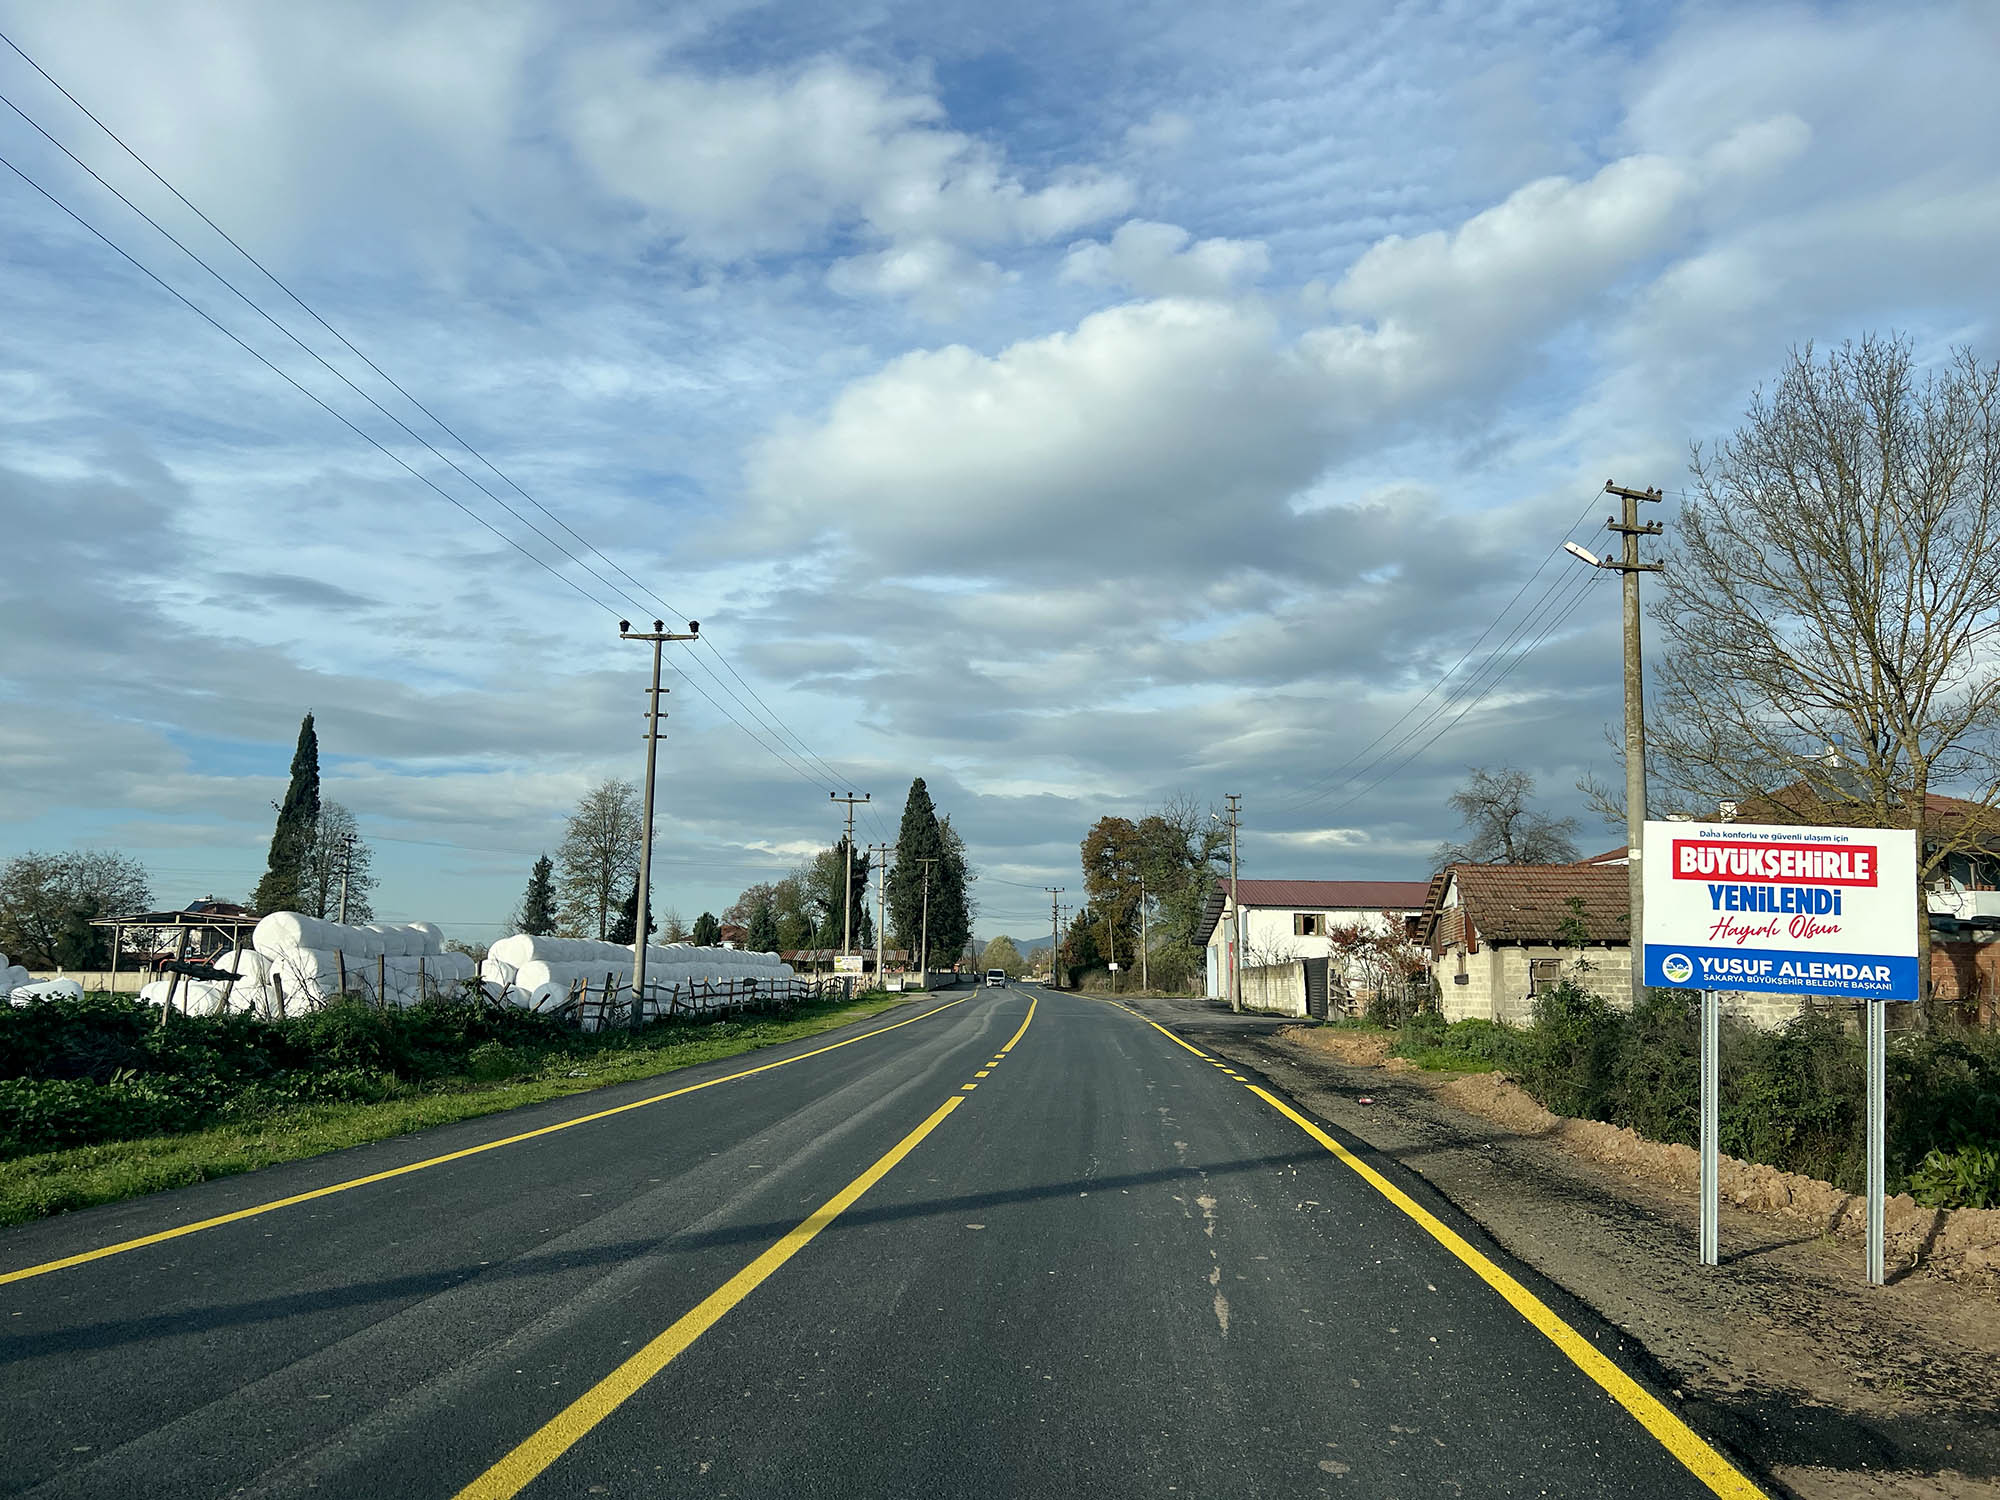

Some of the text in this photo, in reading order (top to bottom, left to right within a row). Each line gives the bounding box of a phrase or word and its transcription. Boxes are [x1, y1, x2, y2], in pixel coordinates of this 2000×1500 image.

[1700, 829, 1721, 838] Daha
[1723, 831, 1757, 839] konforlu
[1771, 833, 1802, 842] güvenli
[1804, 834, 1832, 842] ulaşım
[1833, 834, 1849, 843] için
[1680, 846, 1870, 880] BÜYÜKŞEHİRLE
[1708, 884, 1842, 916] YENİLENDİ
[1709, 915, 1842, 944] Hayırlı Olsun
[1698, 957, 1891, 982] YUSUF ALEMDAR
[1703, 973, 1892, 991] SAKARYA BÜYÜKŞEHİR BELEDİYE BAŞKANI
